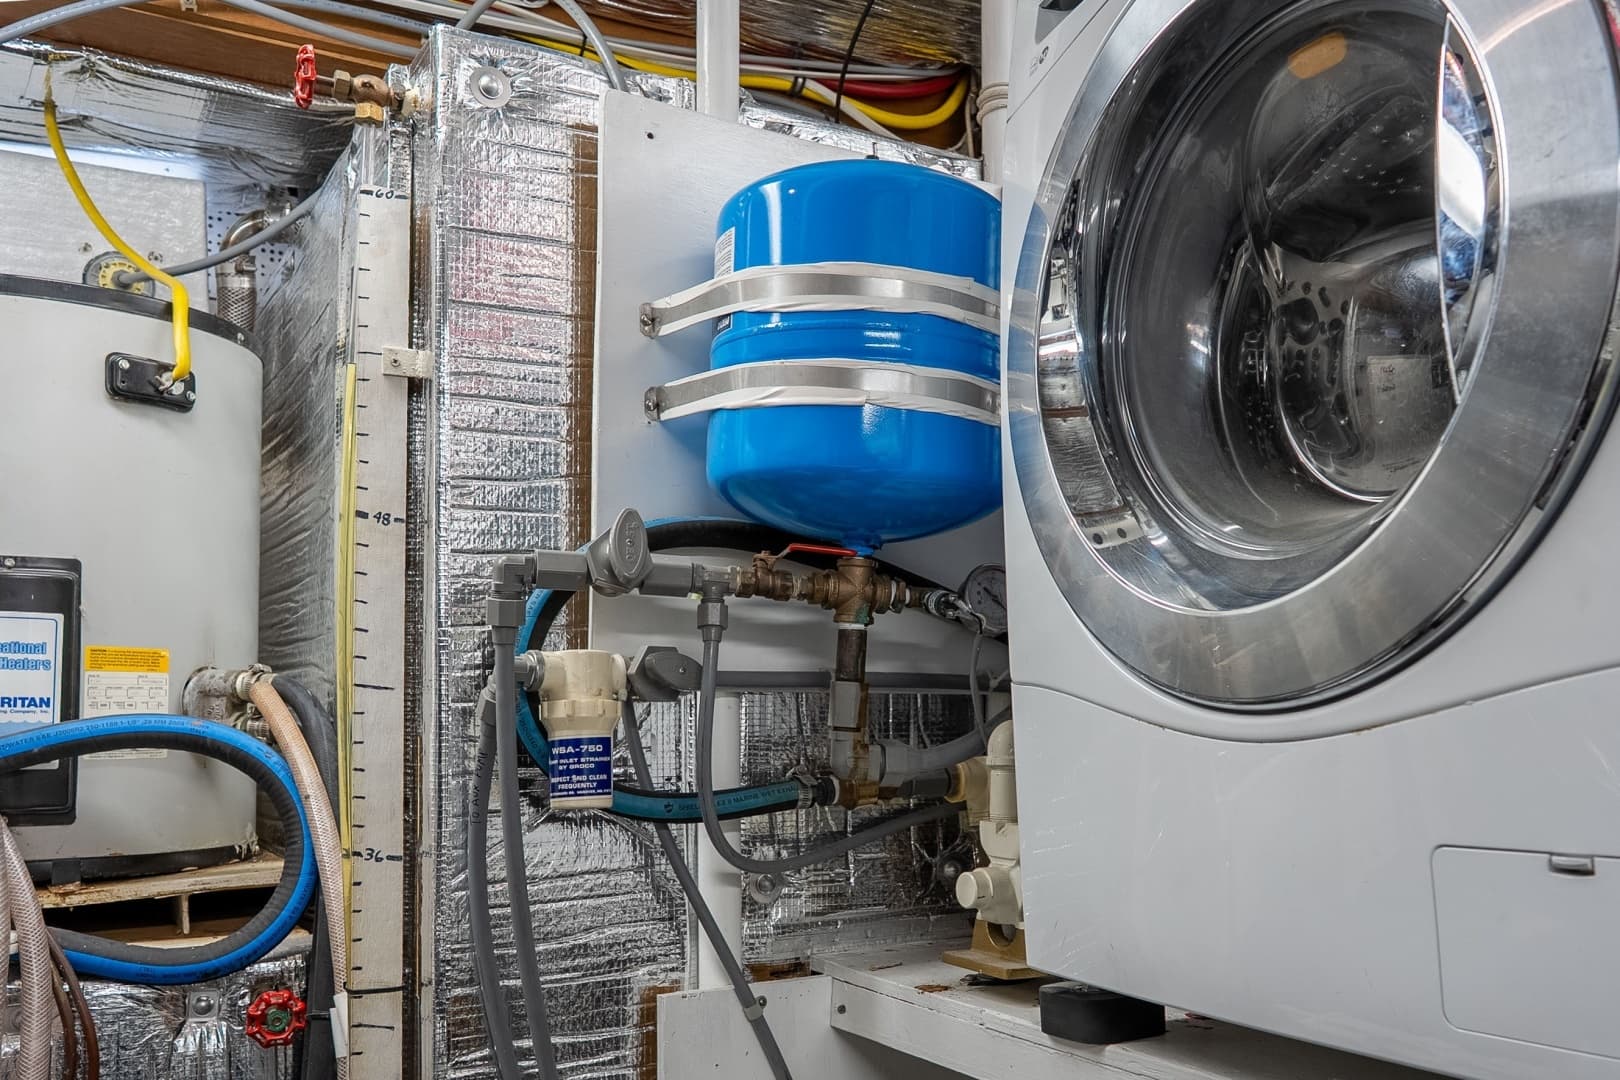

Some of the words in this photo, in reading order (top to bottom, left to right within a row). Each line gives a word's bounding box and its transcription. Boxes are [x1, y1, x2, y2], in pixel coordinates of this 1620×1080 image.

[375, 189, 394, 199] 60
[373, 511, 391, 526] 48
[551, 744, 603, 755] WSA-750
[558, 782, 598, 790] FREQUENTLY
[364, 848, 384, 862] 36
